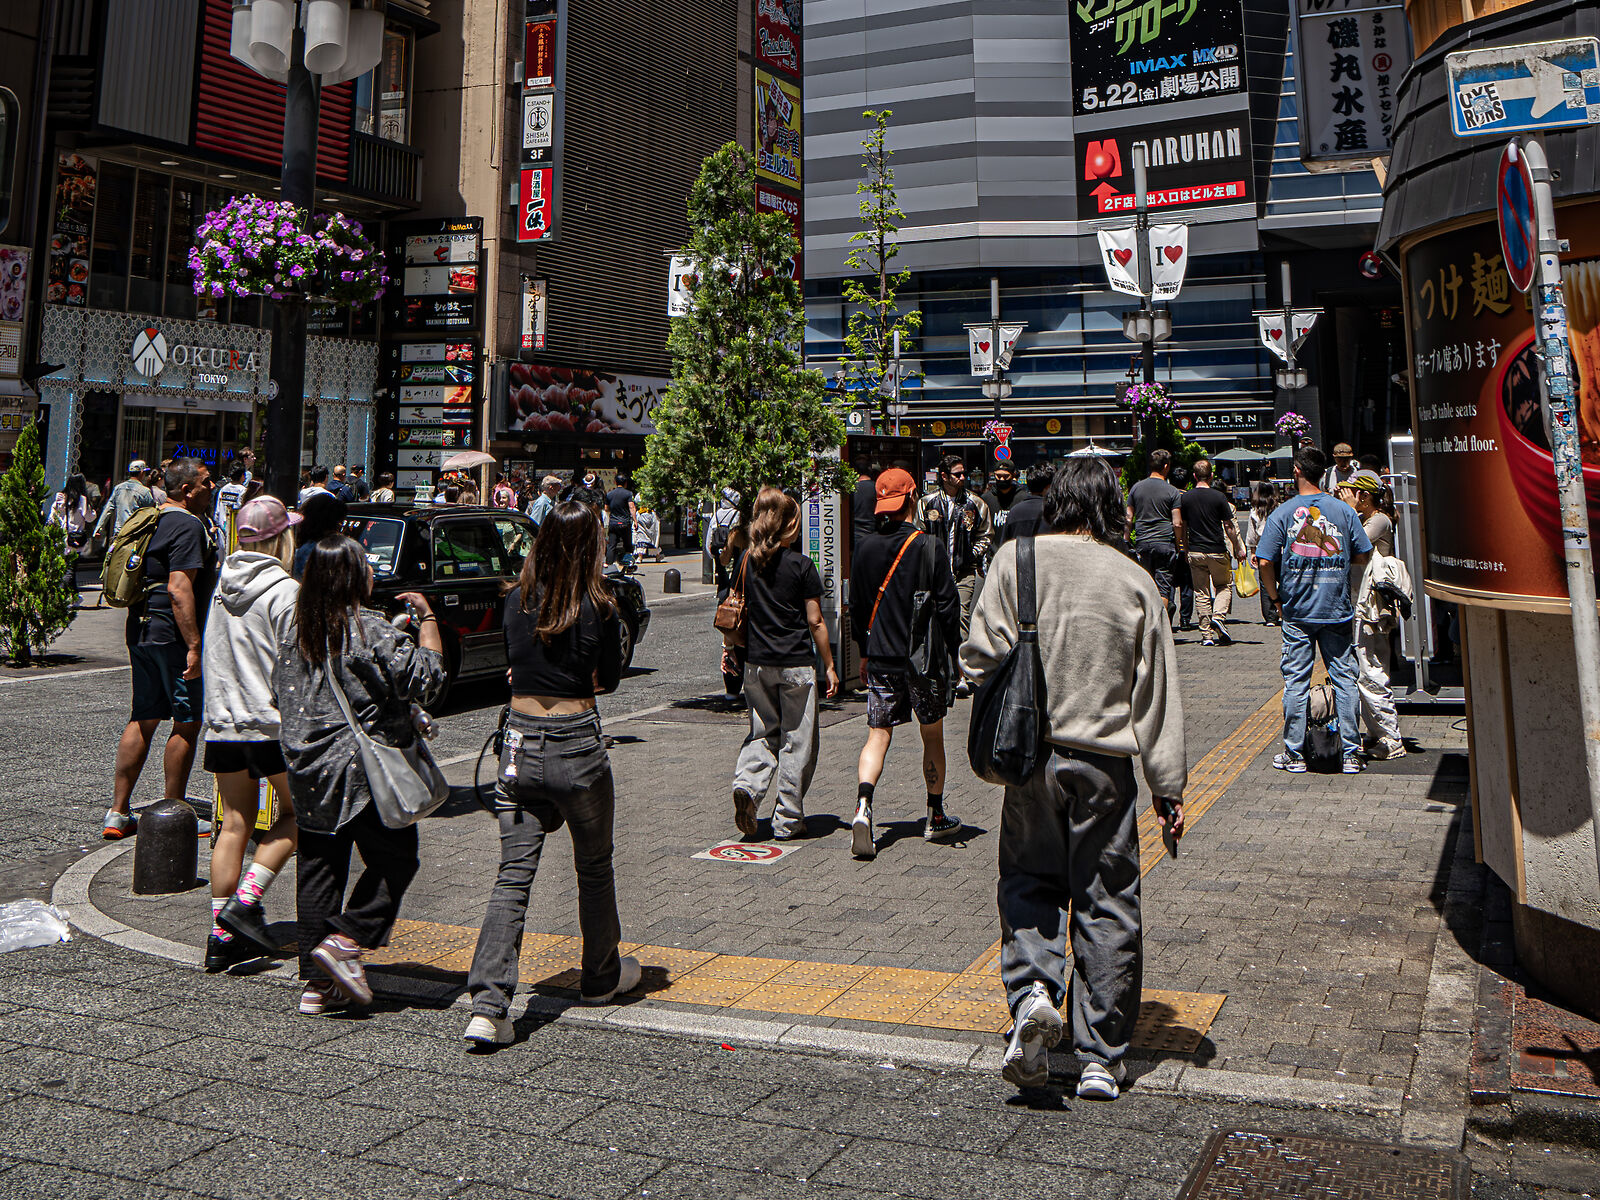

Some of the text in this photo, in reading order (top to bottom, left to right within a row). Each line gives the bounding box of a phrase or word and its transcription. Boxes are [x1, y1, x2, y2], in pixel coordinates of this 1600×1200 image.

[1089, 16, 1116, 36] アンド
[1371, 11, 1388, 49] さかな
[1129, 53, 1188, 75] IMAX
[1192, 43, 1239, 64] MX4D
[1326, 16, 1369, 153] 磯丸水産
[526, 132, 549, 140] SHISHA
[1131, 127, 1242, 169] MARUHAN
[530, 149, 544, 160] 3F
[1103, 184, 1237, 211] 2F店出入口はビル左側
[526, 198, 546, 231] 一休
[1105, 248, 1117, 267] I
[1155, 246, 1165, 267] I
[1420, 251, 1512, 322] つけ麺
[172, 344, 257, 372] OKURA
[199, 373, 228, 385] TOKYO
[615, 379, 671, 423] きづな
[1455, 403, 1477, 418] seats
[1195, 414, 1257, 425] ACORN
[1453, 435, 1469, 452] 2nd
[1470, 434, 1499, 452] floor.
[823, 504, 835, 600] INFORMATION
